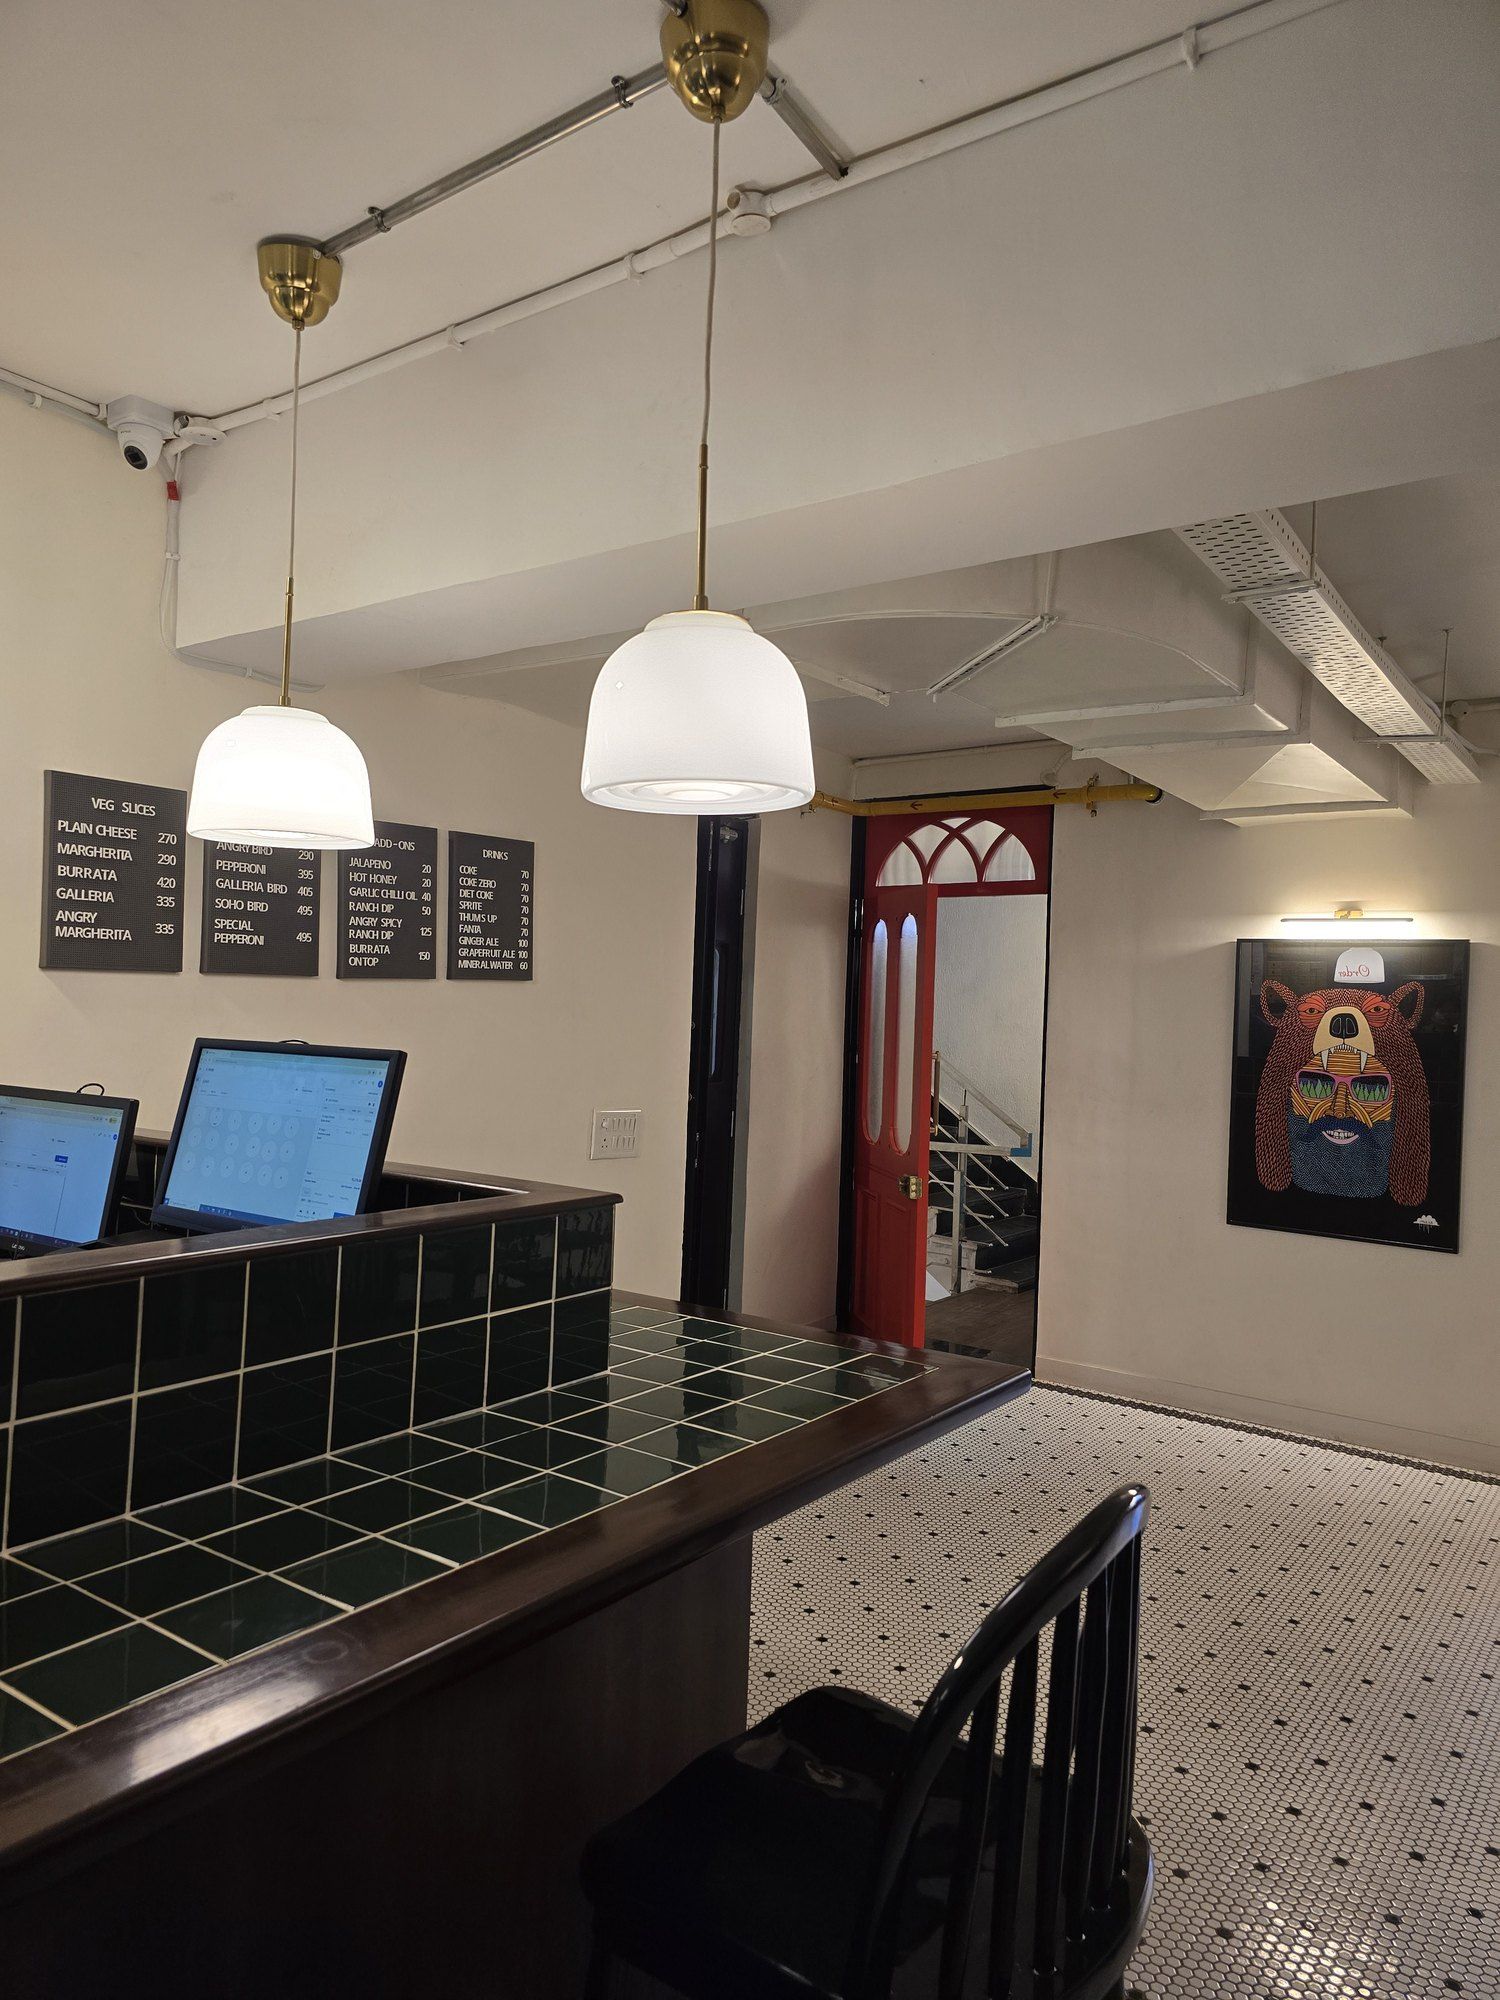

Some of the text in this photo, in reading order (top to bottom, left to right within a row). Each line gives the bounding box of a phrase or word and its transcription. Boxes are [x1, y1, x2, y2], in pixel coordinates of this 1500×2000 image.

[91, 797, 156, 817] VEG SLICES
[57, 819, 177, 845] PLAIN CHEESE 270
[216, 841, 314, 861] ANGRY BIRD 290
[373, 838, 415, 852] ADD-ONS
[57, 842, 177, 866] MARGHERITA 290
[482, 849, 509, 861] DRINKS
[215, 859, 314, 880] PEPPERONI 395
[349, 857, 432, 874] JALAPENO 20
[459, 865, 529, 879] COKE 70
[57, 865, 176, 889] BURRATA 420
[349, 872, 432, 888] HOT HONEY 20
[215, 878, 313, 897] GALLERIA BIRD 405
[459, 877, 529, 892] COKE ZERO 70
[56, 887, 176, 908] GALLERIA 335
[349, 887, 432, 902] GARLIC CHILLI OIL 40
[459, 889, 529, 903] DIET COKE 70
[214, 898, 313, 916] SOHO BIRD 495
[349, 901, 431, 916] RANCH DIP 50
[459, 901, 529, 915] SPRITE 70
[55, 909, 98, 924] ANGRY
[349, 916, 403, 929] ANGRY SPICY
[458, 912, 529, 926] THUMS UP 70
[214, 918, 254, 931] SPECIAL
[458, 924, 529, 937] FANTA 70
[55, 923, 174, 941] MARGHERITA 335
[214, 932, 312, 946] PEPPERONI 495
[349, 927, 432, 940] RANCH DIP 125
[349, 943, 391, 955] BURRATA
[458, 936, 529, 948] GINGER ALE 100
[418, 951, 431, 961] 150
[458, 948, 529, 959] GRAPEFRUIT ALE 100
[458, 959, 528, 971] MINERAL WATER 60
